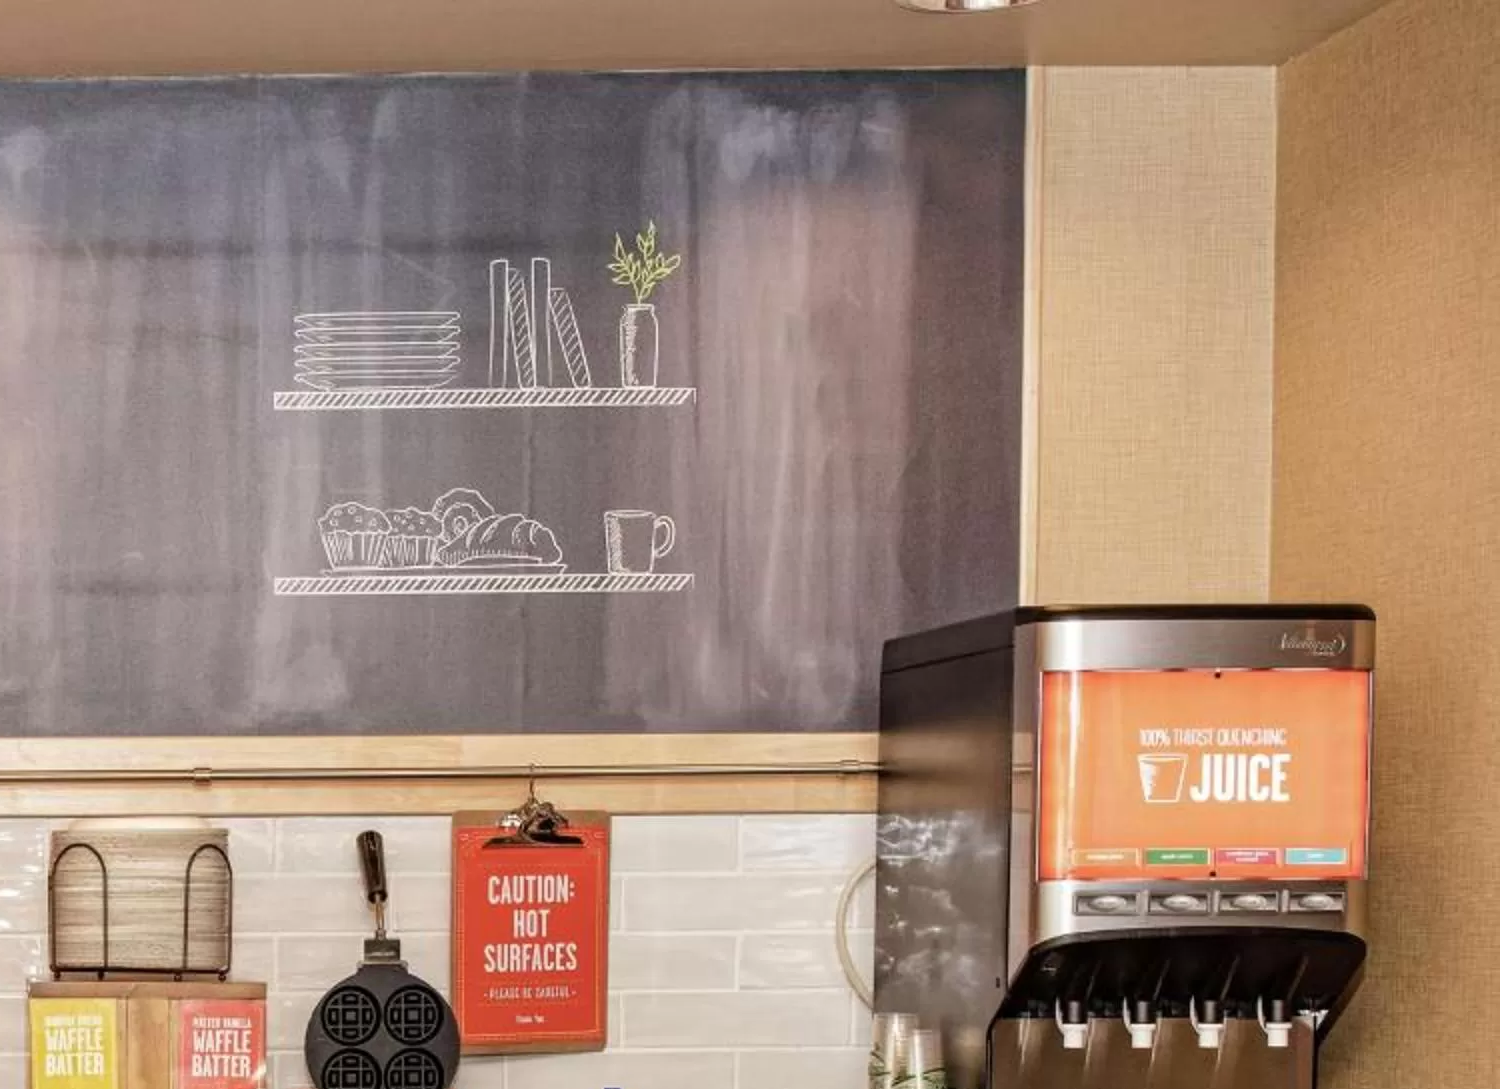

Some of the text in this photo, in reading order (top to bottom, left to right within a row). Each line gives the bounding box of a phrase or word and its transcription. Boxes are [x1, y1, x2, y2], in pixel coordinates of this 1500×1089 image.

[1140, 728, 1288, 746] 100% THIRST QUENCHING
[1189, 753, 1292, 803] JUICE
[487, 875, 576, 905] CAUTION:
[513, 909, 550, 938] HOT
[484, 943, 577, 973] SURFACES
[44, 1028, 104, 1051] WAFFLE
[192, 1029, 252, 1053] WAFFLE
[45, 1052, 105, 1077] BATTER
[191, 1054, 251, 1078] BATTER
